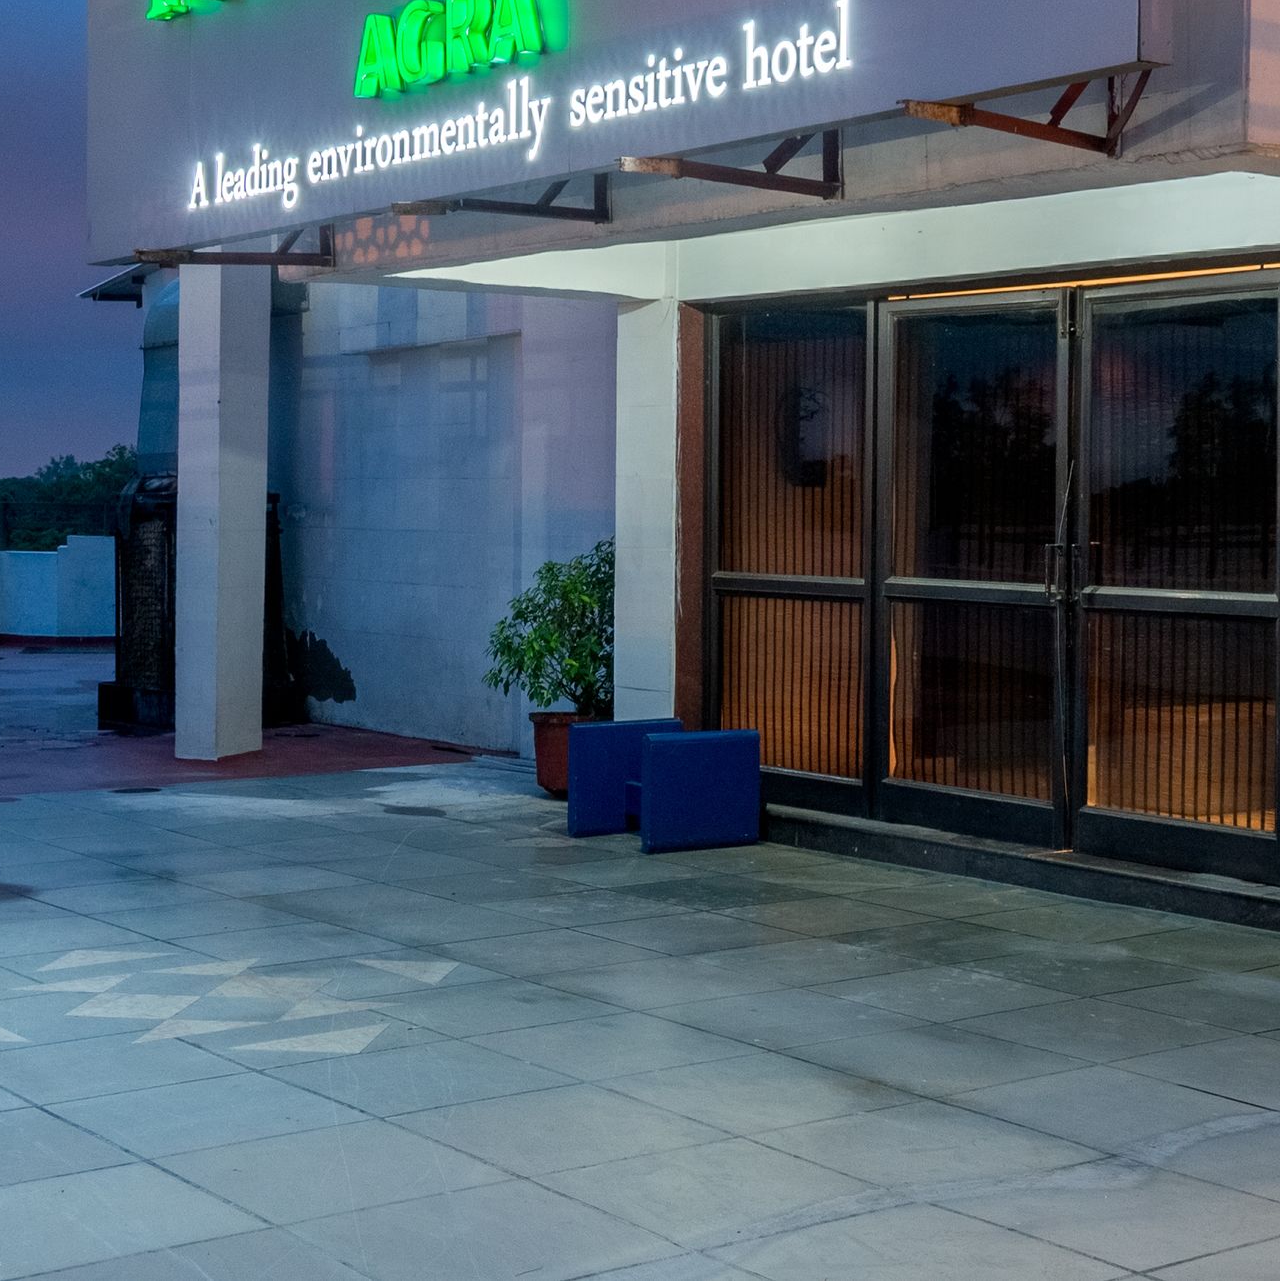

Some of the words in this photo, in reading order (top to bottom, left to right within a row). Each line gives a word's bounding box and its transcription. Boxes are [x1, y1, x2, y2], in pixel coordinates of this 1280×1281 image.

[189, 160, 209, 209] A
[215, 145, 298, 209] leading
[306, 77, 550, 184] environmentally
[569, 49, 727, 128] sensitive
